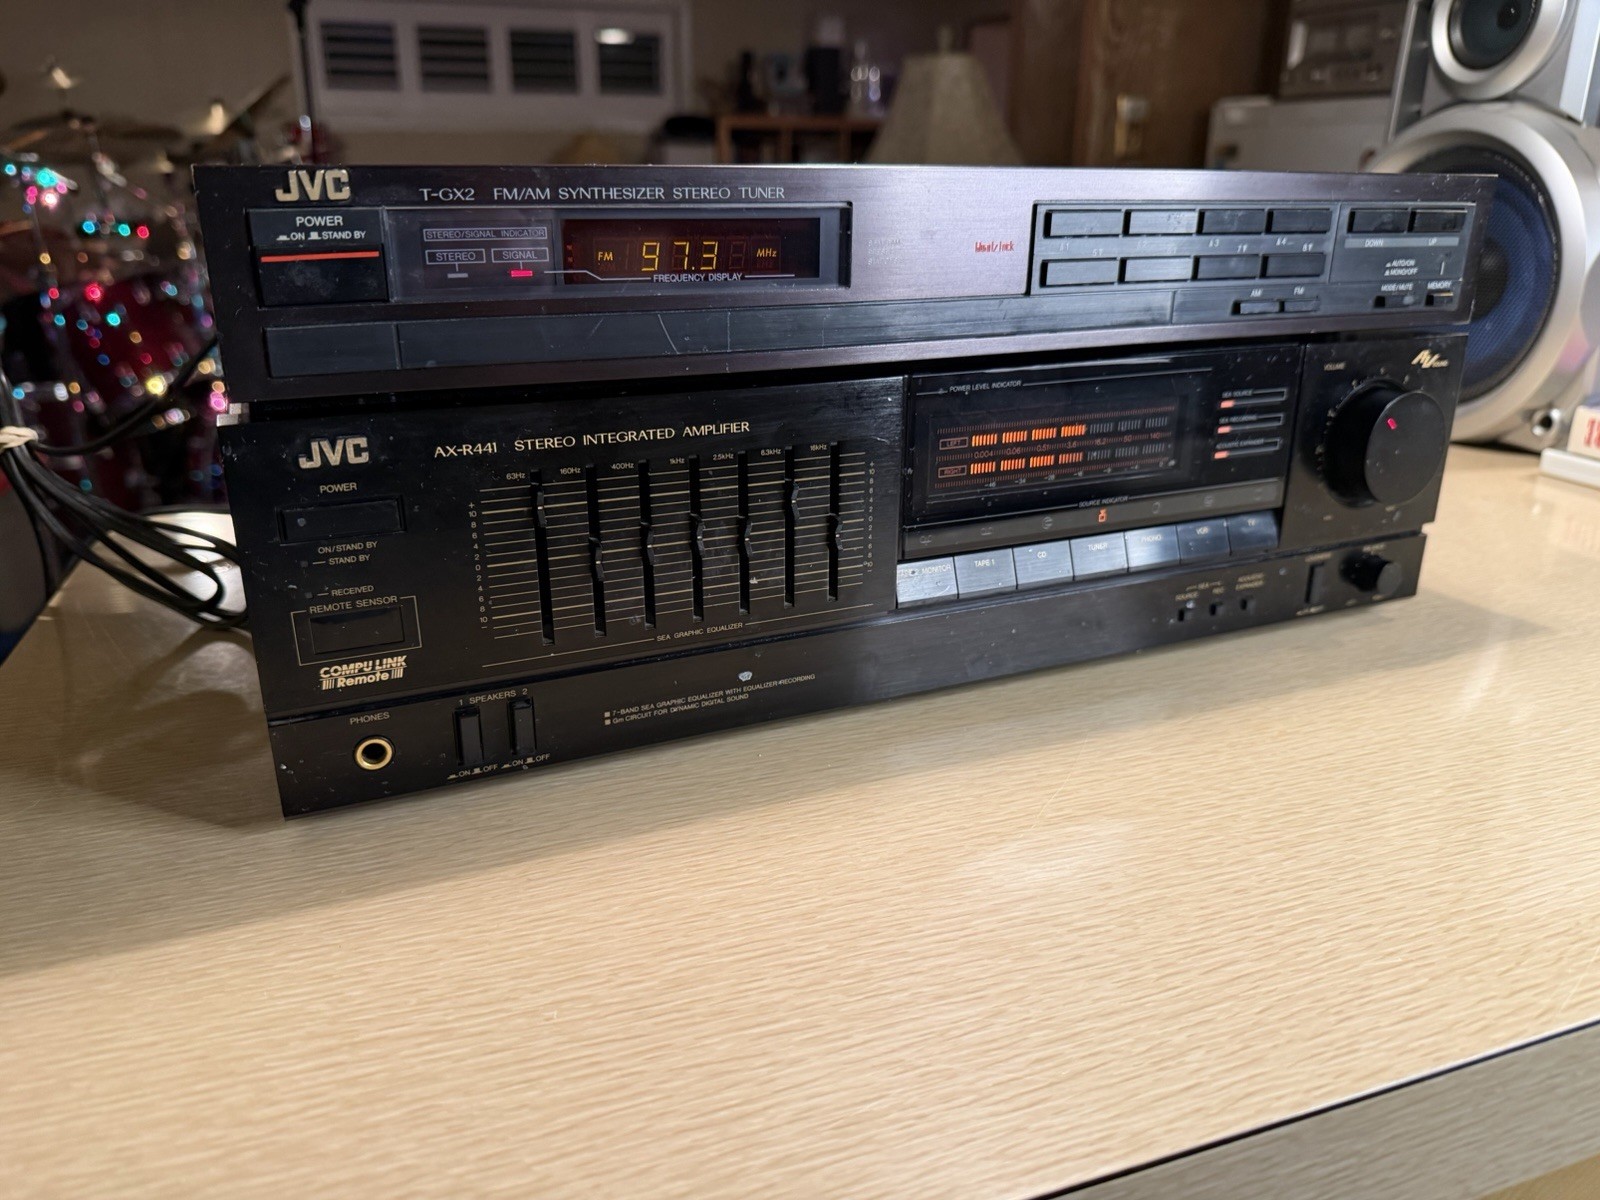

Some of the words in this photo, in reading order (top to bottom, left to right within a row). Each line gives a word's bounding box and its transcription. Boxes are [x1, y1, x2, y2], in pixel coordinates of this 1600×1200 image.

[275, 169, 350, 202] JVC
[419, 188, 475, 201] T-GX2
[494, 188, 550, 200] FM/AM
[558, 187, 665, 200] SYNTHESIZER
[672, 187, 731, 199] STEREO
[738, 187, 785, 199] TUNER
[296, 216, 343, 227] POWER
[290, 232, 305, 241] ON
[322, 231, 352, 240] STAND
[354, 230, 366, 239] BY
[426, 230, 496, 239] STEREO/SIGNAL
[500, 229, 545, 238] INDICATOR
[436, 252, 476, 261] STEREO
[502, 251, 538, 260] SIGNAL
[598, 252, 613, 261] FM
[642, 242, 718, 271] 97.3
[756, 248, 777, 258] MHz
[654, 273, 705, 283] FREQUENCY
[708, 272, 743, 281] DISPLAY
[950, 384, 971, 392] POWER
[992, 380, 1022, 389] INDICATOR
[434, 442, 498, 458] AX-R441
[514, 436, 576, 451] STEREO
[583, 428, 675, 446] INTEGRATED
[682, 422, 750, 437] AMPLIFIER
[298, 436, 369, 469] JVC
[320, 482, 357, 493] POWER
[318, 542, 364, 554] ON/STAND
[366, 541, 378, 549] BY
[328, 555, 357, 566] STAND
[358, 554, 371, 562] BY
[332, 585, 374, 597] RECEIVED
[310, 602, 352, 614] REMOTE
[356, 596, 398, 608] SENSOR
[656, 633, 671, 642] SEA
[674, 628, 704, 639] GRAPHIC
[706, 622, 743, 634] EQUALIZER
[320, 660, 373, 678] COMPU
[376, 655, 407, 669] LINK
[337, 671, 390, 688] Remote
[469, 690, 517, 704] SPEAKERS
[656, 697, 686, 709] GRAPHIC
[688, 690, 724, 703] EQUALIZER
[726, 687, 742, 696] WITH
[625, 712, 652, 722] CIRCUIT
[654, 709, 669, 717] FOR
[701, 697, 725, 707] DIGITAL
[726, 693, 749, 703] SOUND
[350, 712, 390, 725] PHONES
[512, 759, 524, 767] ON
[536, 753, 550, 762] OFF
[482, 764, 499, 773] OFF
